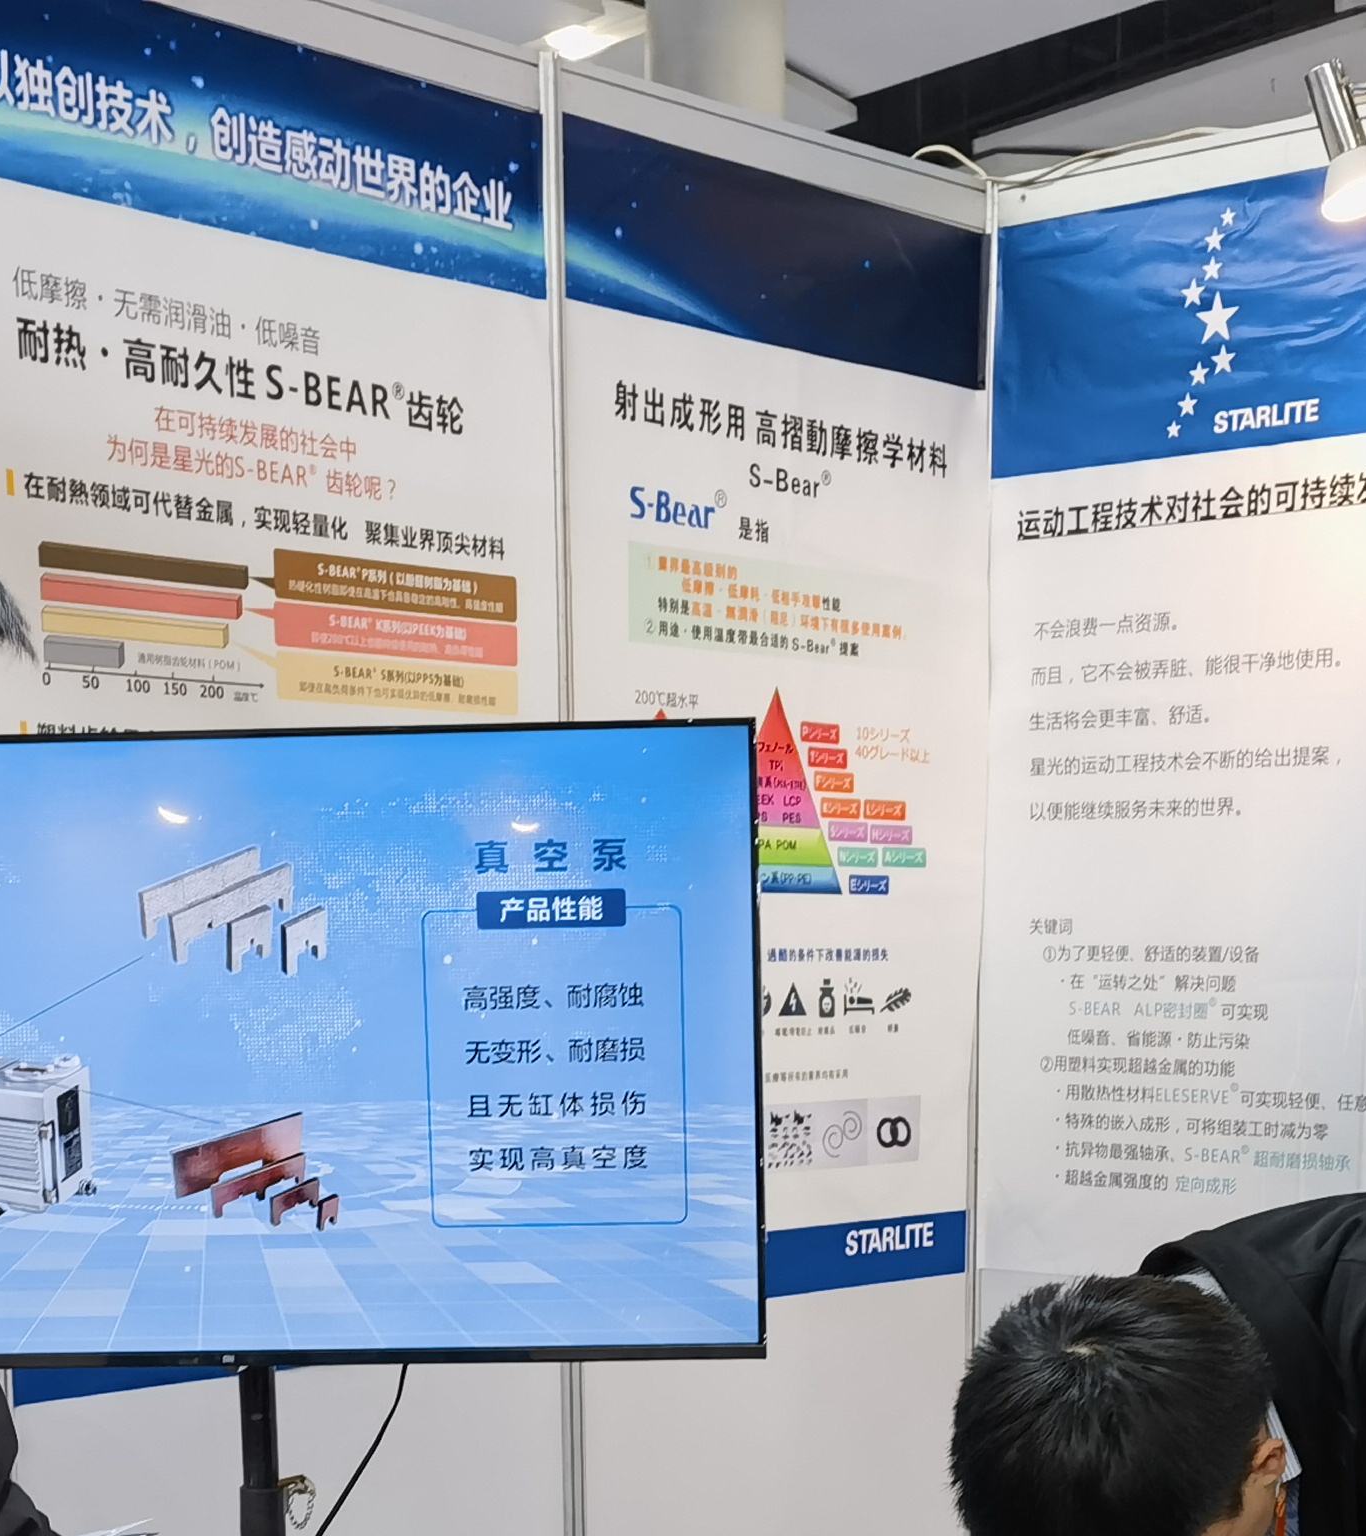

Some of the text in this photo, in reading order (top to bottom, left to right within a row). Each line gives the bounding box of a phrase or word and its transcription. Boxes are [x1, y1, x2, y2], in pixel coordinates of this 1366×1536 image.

[615, 379, 746, 442] 射出成形用
[1213, 398, 1320, 434] STARLITE
[154, 405, 358, 459] 在可持续发展的社会中
[365, 520, 506, 560] 聚集业界顶尖材料
[738, 517, 769, 544] 是指
[1034, 611, 1179, 642] 不会浪费一点资源。
[1030, 646, 1343, 687] 而且，它不会被弄脏、能很干净地使用。
[42, 672, 51, 686] 0
[82, 675, 100, 690] 50
[126, 678, 151, 694] 100
[163, 682, 187, 697] 150
[200, 684, 225, 700] 200
[1028, 703, 1212, 732] 生活将会更丰富、舒适。
[1029, 796, 1242, 823] 以便能继续服务未来的世界。
[474, 837, 628, 875] 真空泵
[498, 895, 605, 923] 产品性能
[1029, 918, 1074, 935] 关键词
[462, 981, 645, 1012] 高强度、耐腐蚀
[1068, 1001, 1121, 1017] S-BEAR
[1221, 1003, 1269, 1022] 可实现
[464, 1036, 647, 1067] 无变形、耐磨损
[466, 1090, 647, 1119] 且无缸体损伤
[468, 1144, 649, 1173] 实现高真空度
[1253, 1150, 1352, 1173] 超耐磨损轴承
[1064, 1168, 1237, 1196] 超越金属强度的 定向成形
[844, 1221, 935, 1257] STARLITE
